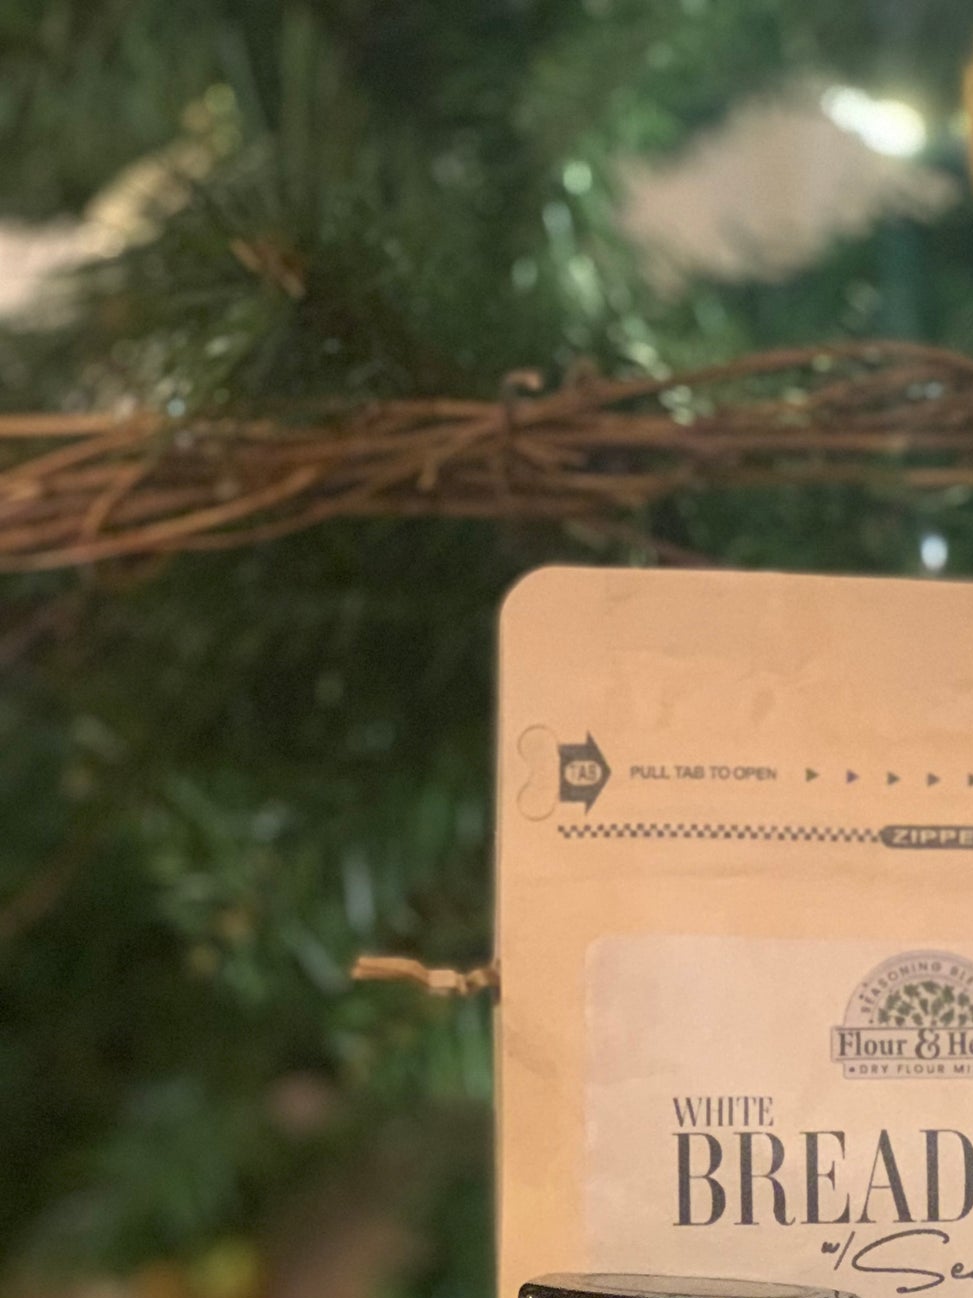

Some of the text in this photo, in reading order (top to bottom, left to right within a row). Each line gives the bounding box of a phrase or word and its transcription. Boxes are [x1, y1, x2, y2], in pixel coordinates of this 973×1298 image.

[629, 765, 778, 781] PULL TAB TO OPEN
[860, 961, 942, 1014] SEASONING
[838, 1030, 908, 1057] Flour
[914, 1028, 941, 1060] &
[859, 1063, 889, 1075] DRY
[897, 1062, 946, 1075] FLOUR
[672, 1096, 775, 1128] WHITE
